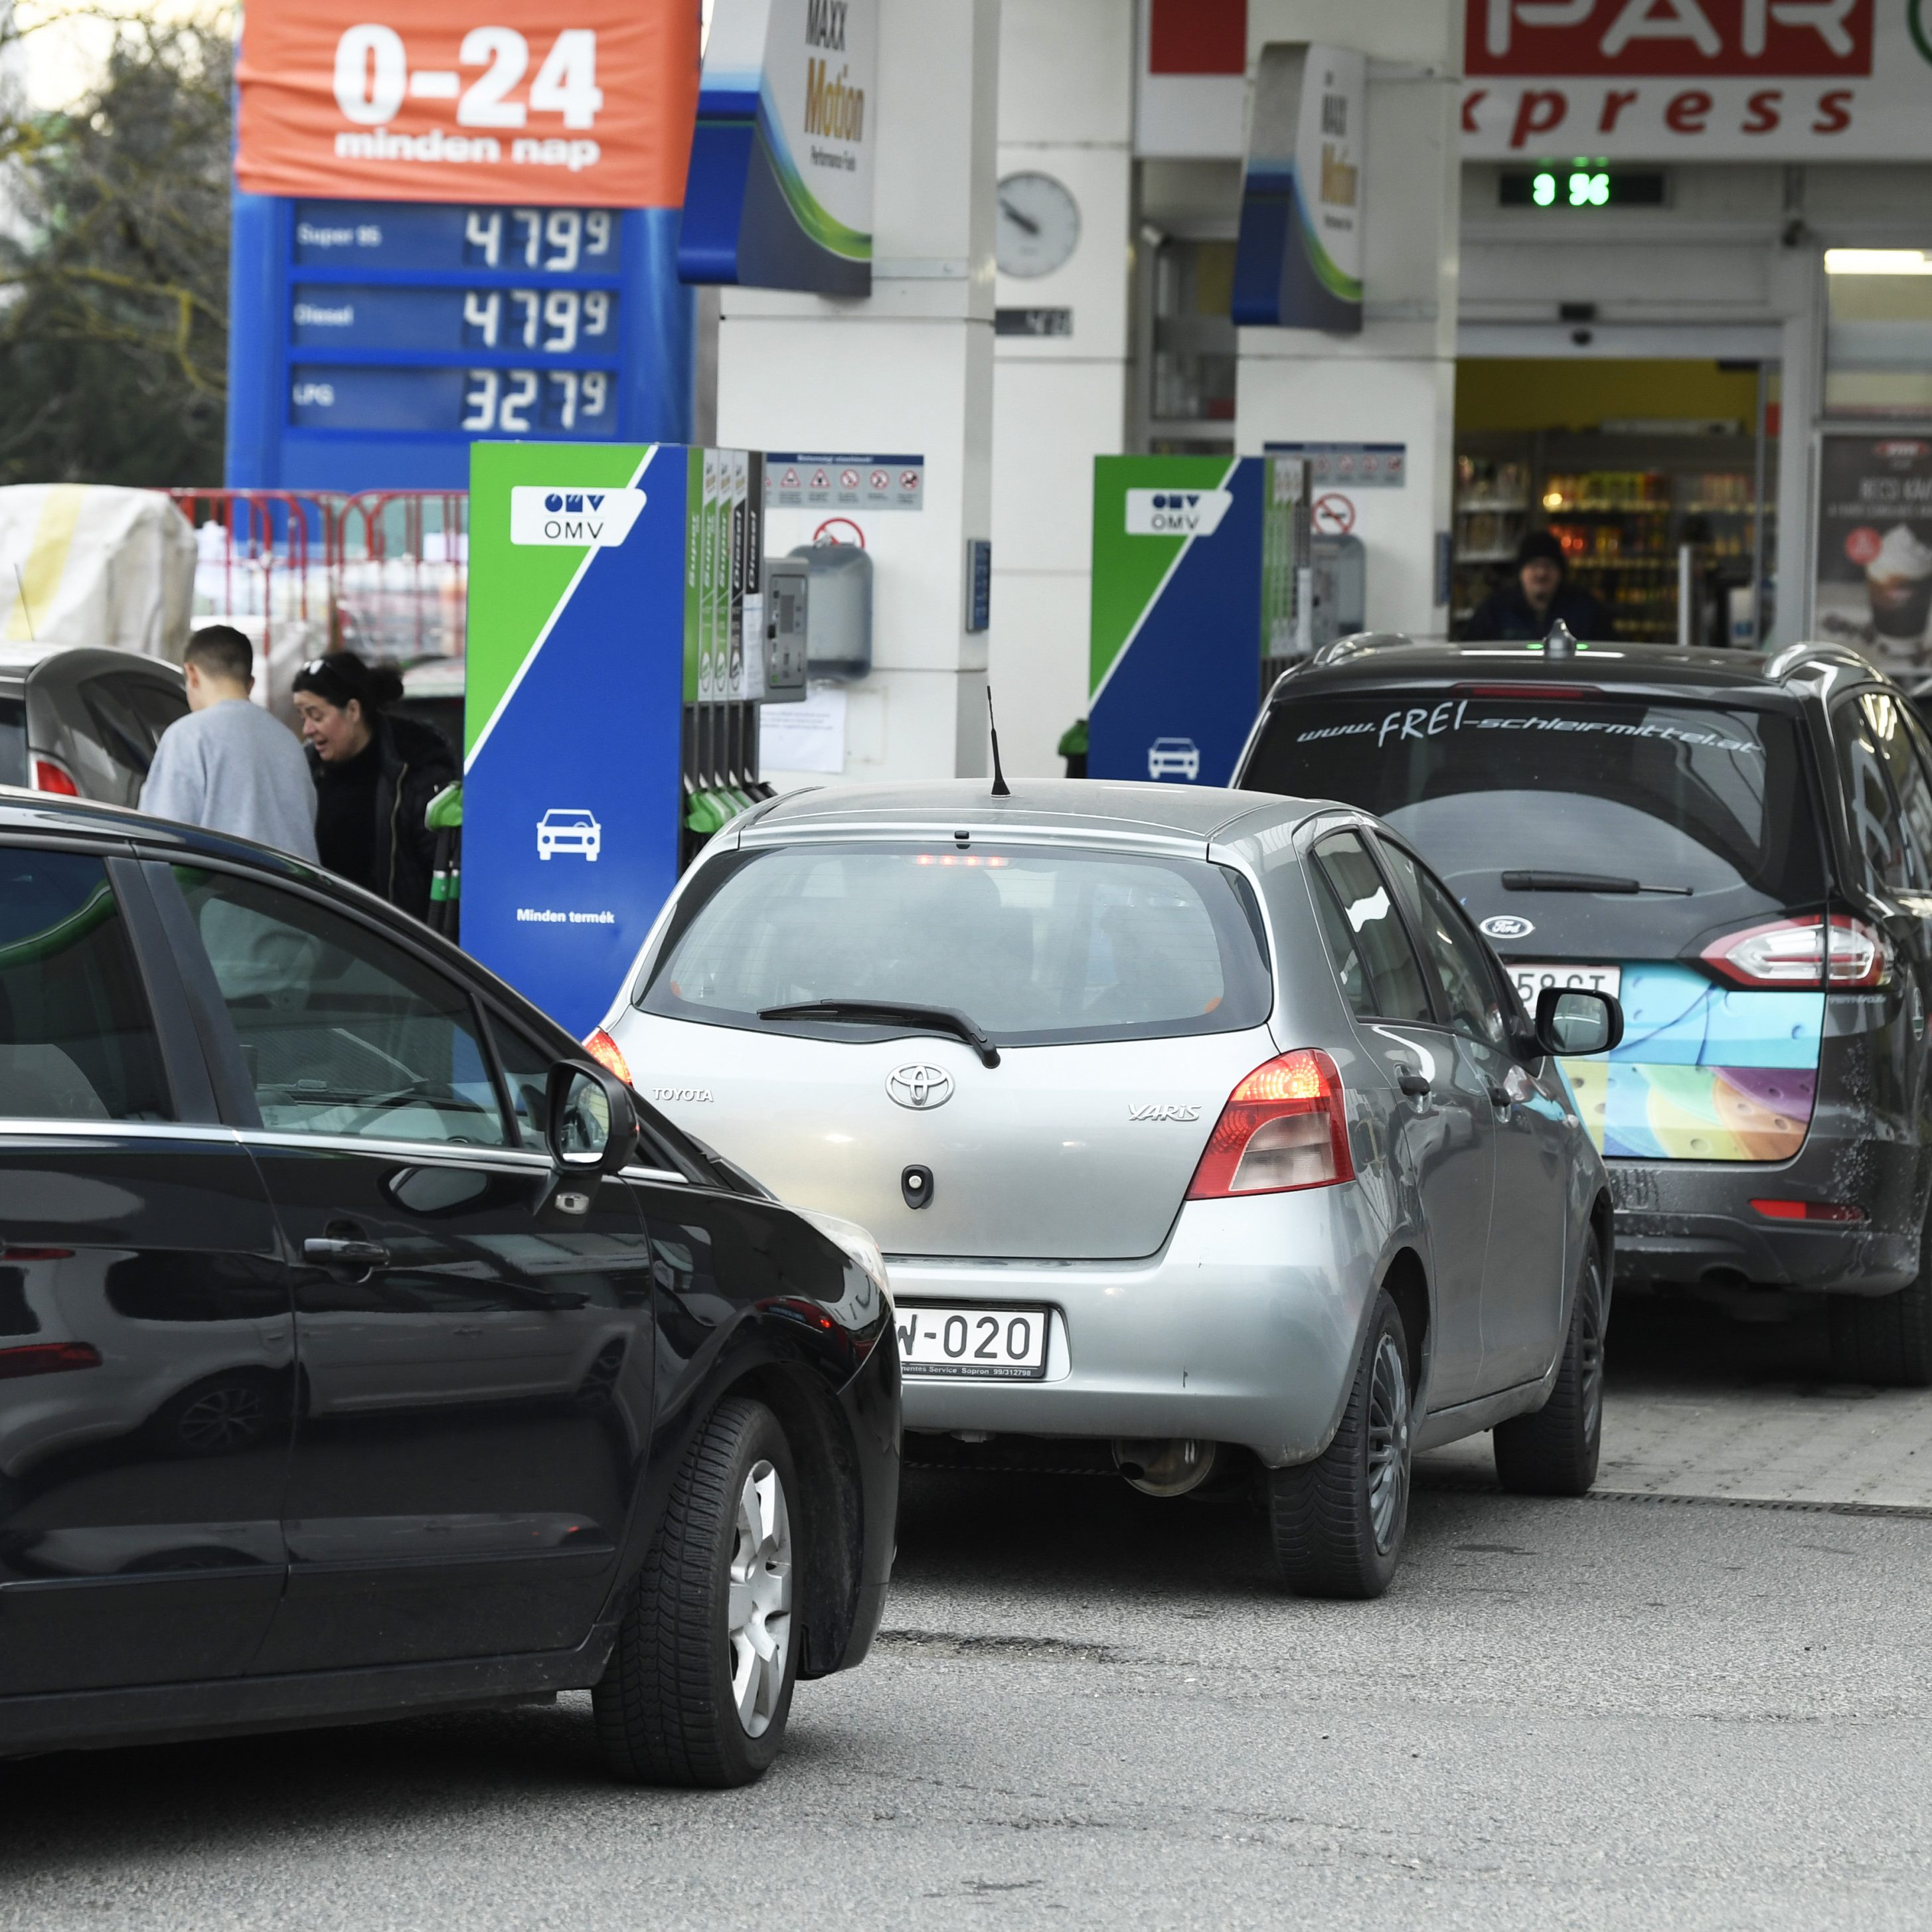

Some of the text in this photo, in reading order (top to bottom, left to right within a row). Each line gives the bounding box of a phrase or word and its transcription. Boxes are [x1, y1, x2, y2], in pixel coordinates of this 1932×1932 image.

[332, 23, 604, 129] 0-24
[804, 56, 865, 142] Motion
[334, 125, 601, 172] minden nap
[297, 222, 354, 250] Super
[293, 302, 355, 327] Diesel
[544, 521, 604, 539] OMV
[1152, 514, 1201, 531] OMV
[734, 510, 742, 590] Diesel
[748, 510, 757, 589] Diesel
[517, 908, 615, 924] Minden termék
[1491, 920, 1522, 934] Ford
[653, 1087, 714, 1103] TOYOTA
